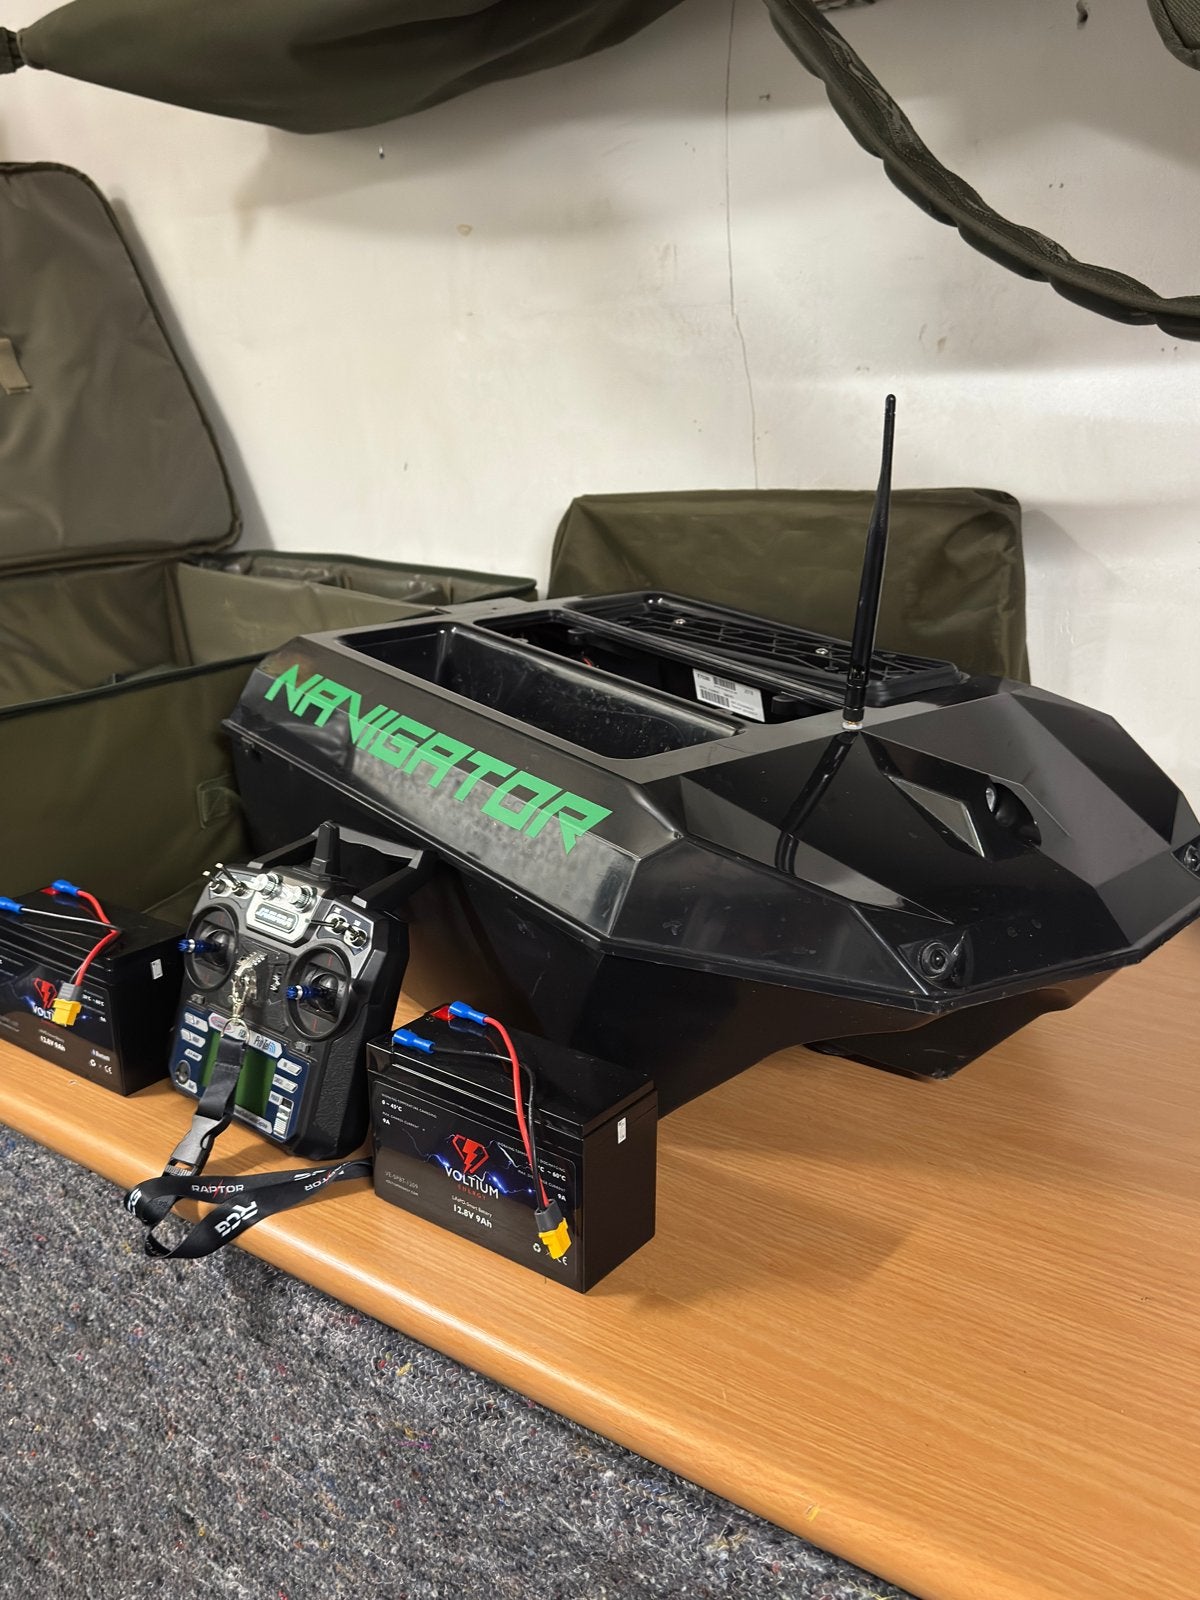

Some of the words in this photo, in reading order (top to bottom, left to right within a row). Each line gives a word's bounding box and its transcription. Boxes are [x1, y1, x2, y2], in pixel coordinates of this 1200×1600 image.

[264, 664, 613, 856] NAVIGATOR
[382, 1117, 391, 1125] 9A
[191, 1182, 245, 1195] RAPTOR
[444, 1165, 499, 1200] VOLTIUM
[557, 1193, 567, 1202] 9A
[214, 1200, 259, 1238] RCG
[453, 1203, 475, 1219] 12.8V
[475, 1214, 493, 1229] 9Ah
